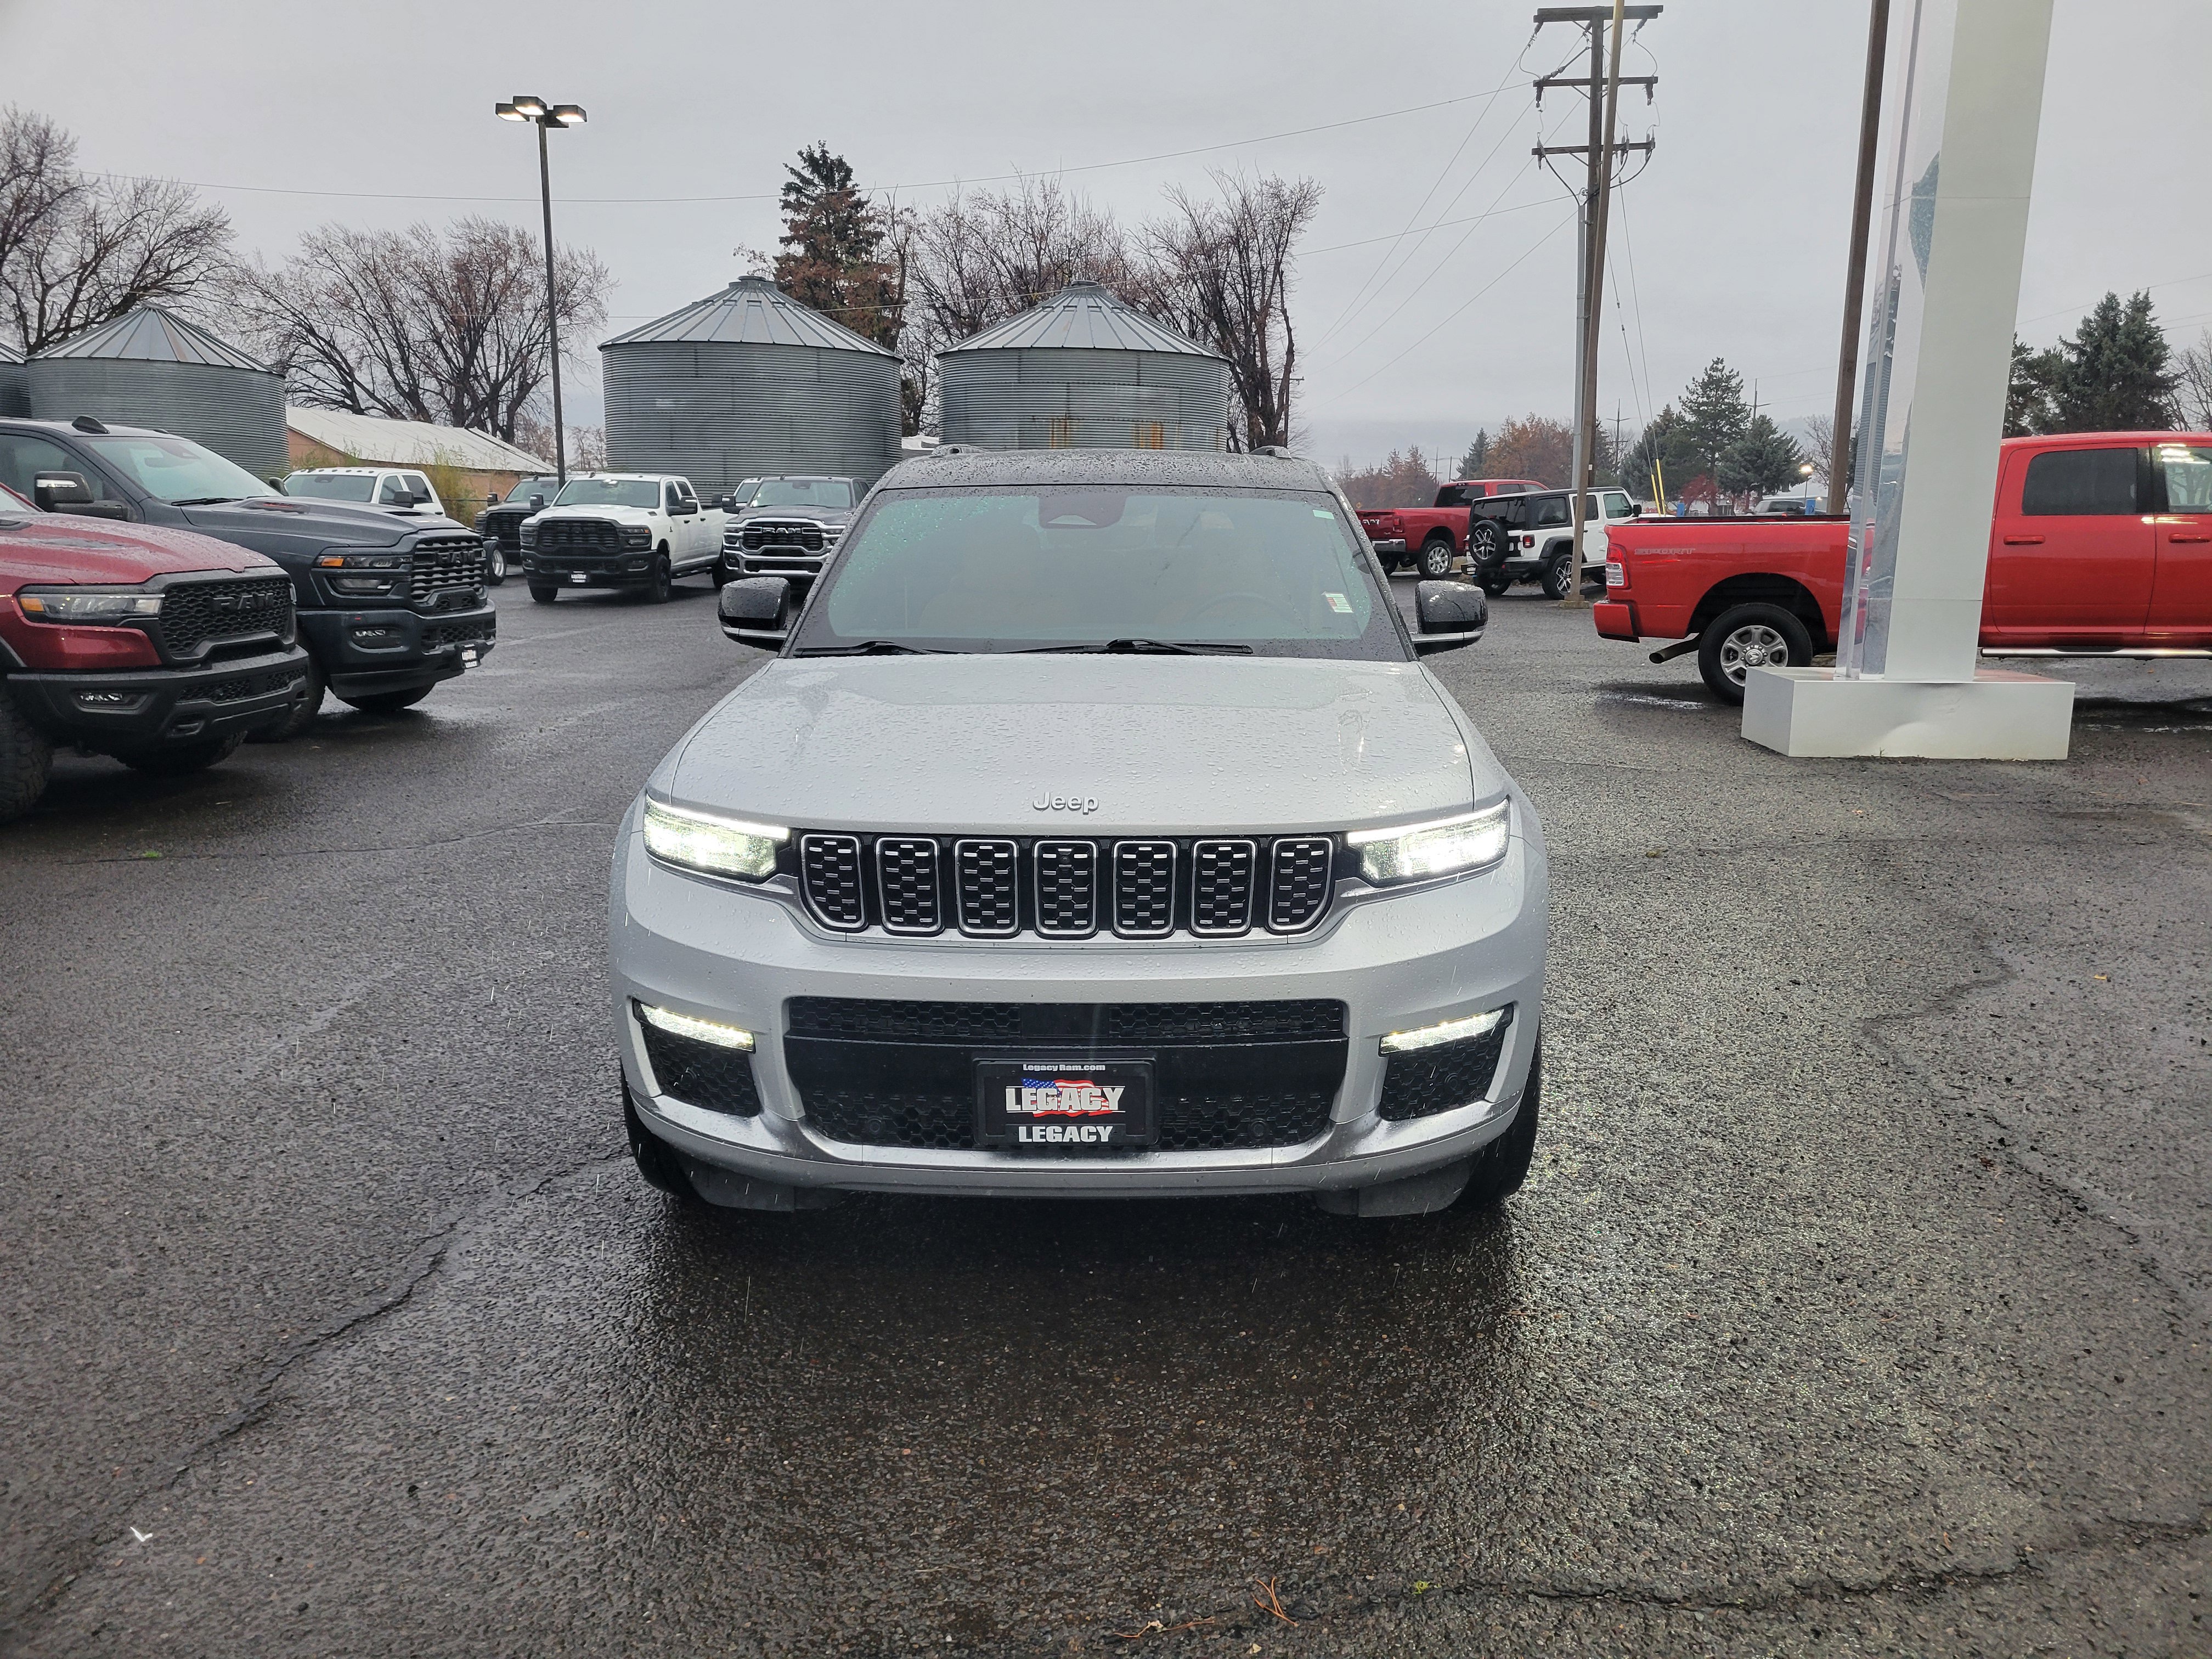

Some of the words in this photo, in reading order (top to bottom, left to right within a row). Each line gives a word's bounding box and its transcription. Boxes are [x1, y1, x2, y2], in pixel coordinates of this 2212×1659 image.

[437, 550, 475, 565] RAM
[212, 592, 274, 611] RAM
[1032, 792, 1099, 815] Jeep
[1005, 1087, 1125, 1111] LEGACY
[1018, 1126, 1113, 1142] LEGACY
